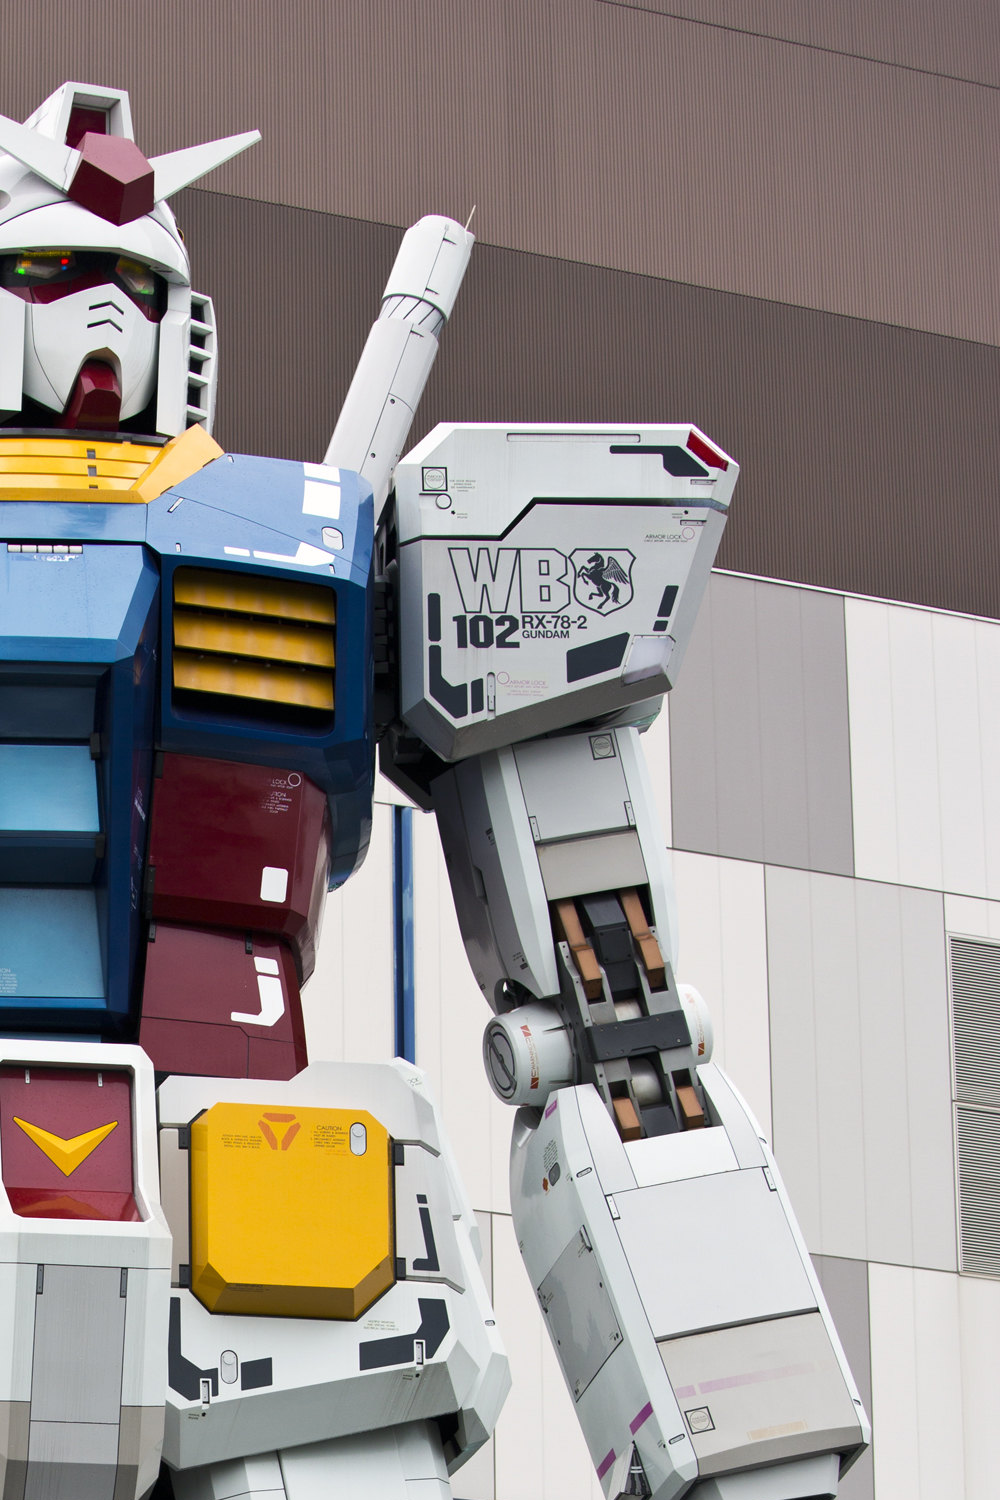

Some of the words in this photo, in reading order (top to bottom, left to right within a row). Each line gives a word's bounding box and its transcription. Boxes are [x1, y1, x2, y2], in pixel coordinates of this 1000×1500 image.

[447, 547, 571, 614] WB
[452, 614, 520, 648] 102
[521, 615, 588, 629] RX-78-2
[522, 630, 570, 639] GUNDAM
